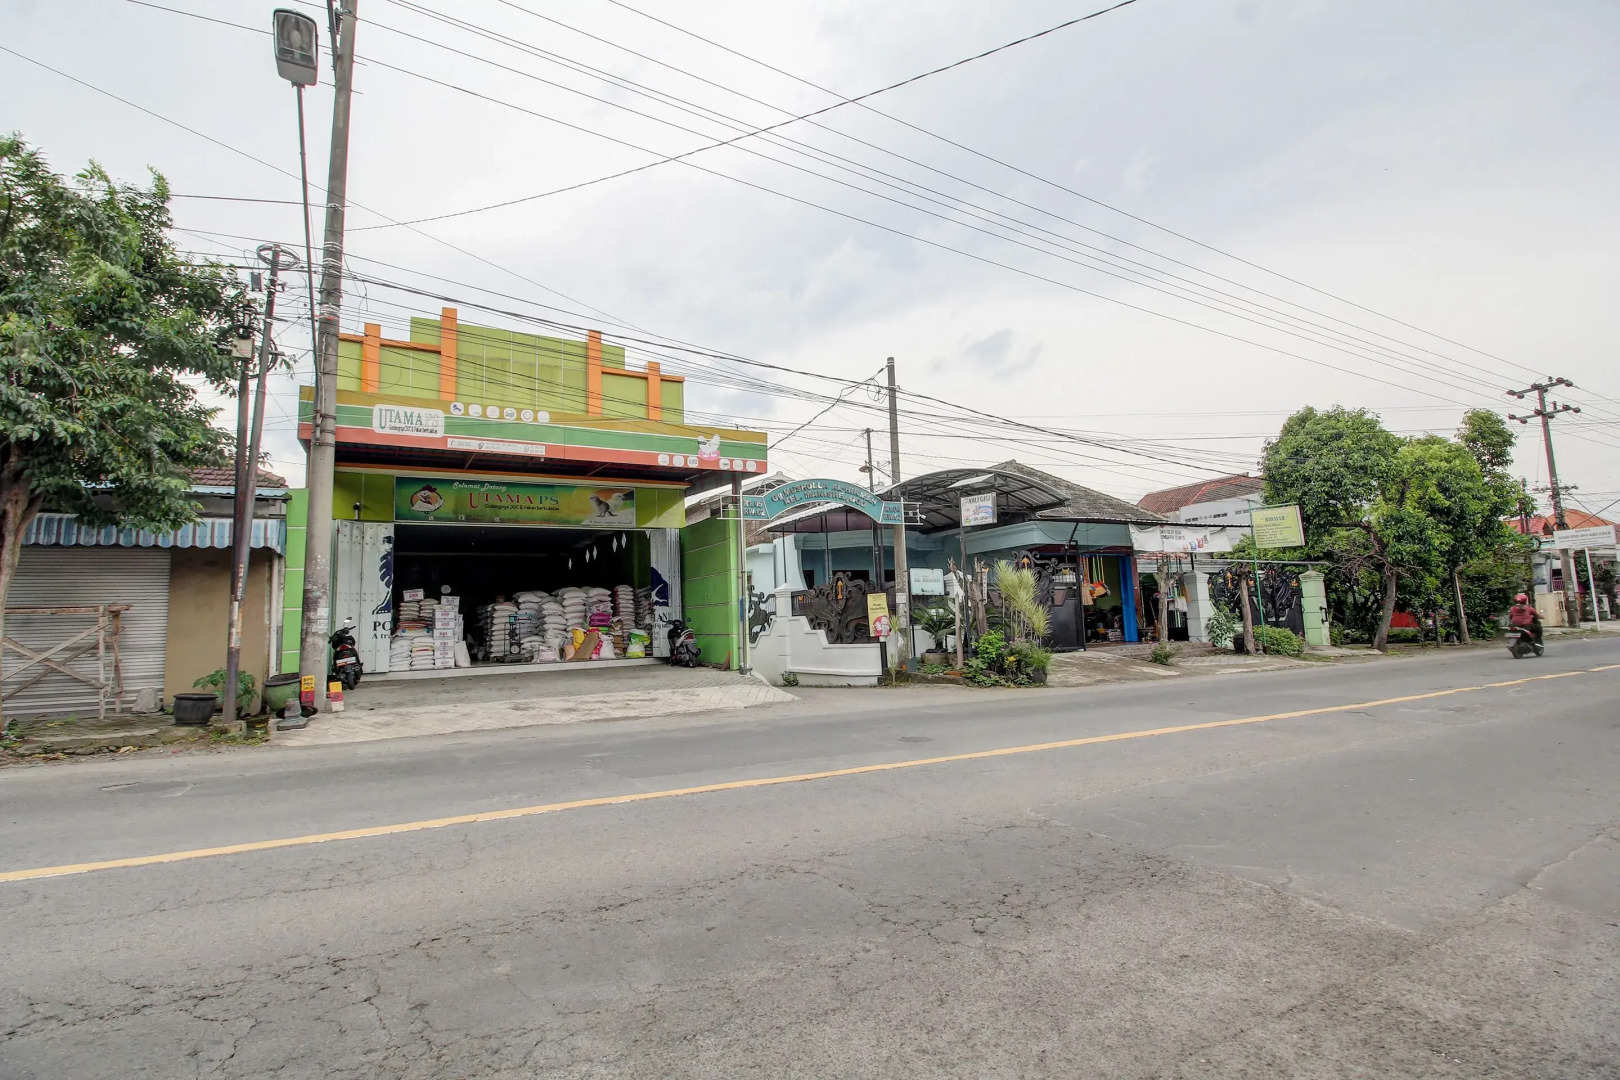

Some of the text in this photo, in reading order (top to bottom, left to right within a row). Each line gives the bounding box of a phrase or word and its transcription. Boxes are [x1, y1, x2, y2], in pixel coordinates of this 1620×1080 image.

[379, 408, 423, 430] UTAMA
[453, 482, 507, 492] Selamat Datang
[469, 492, 559, 510] UTAMA PS
